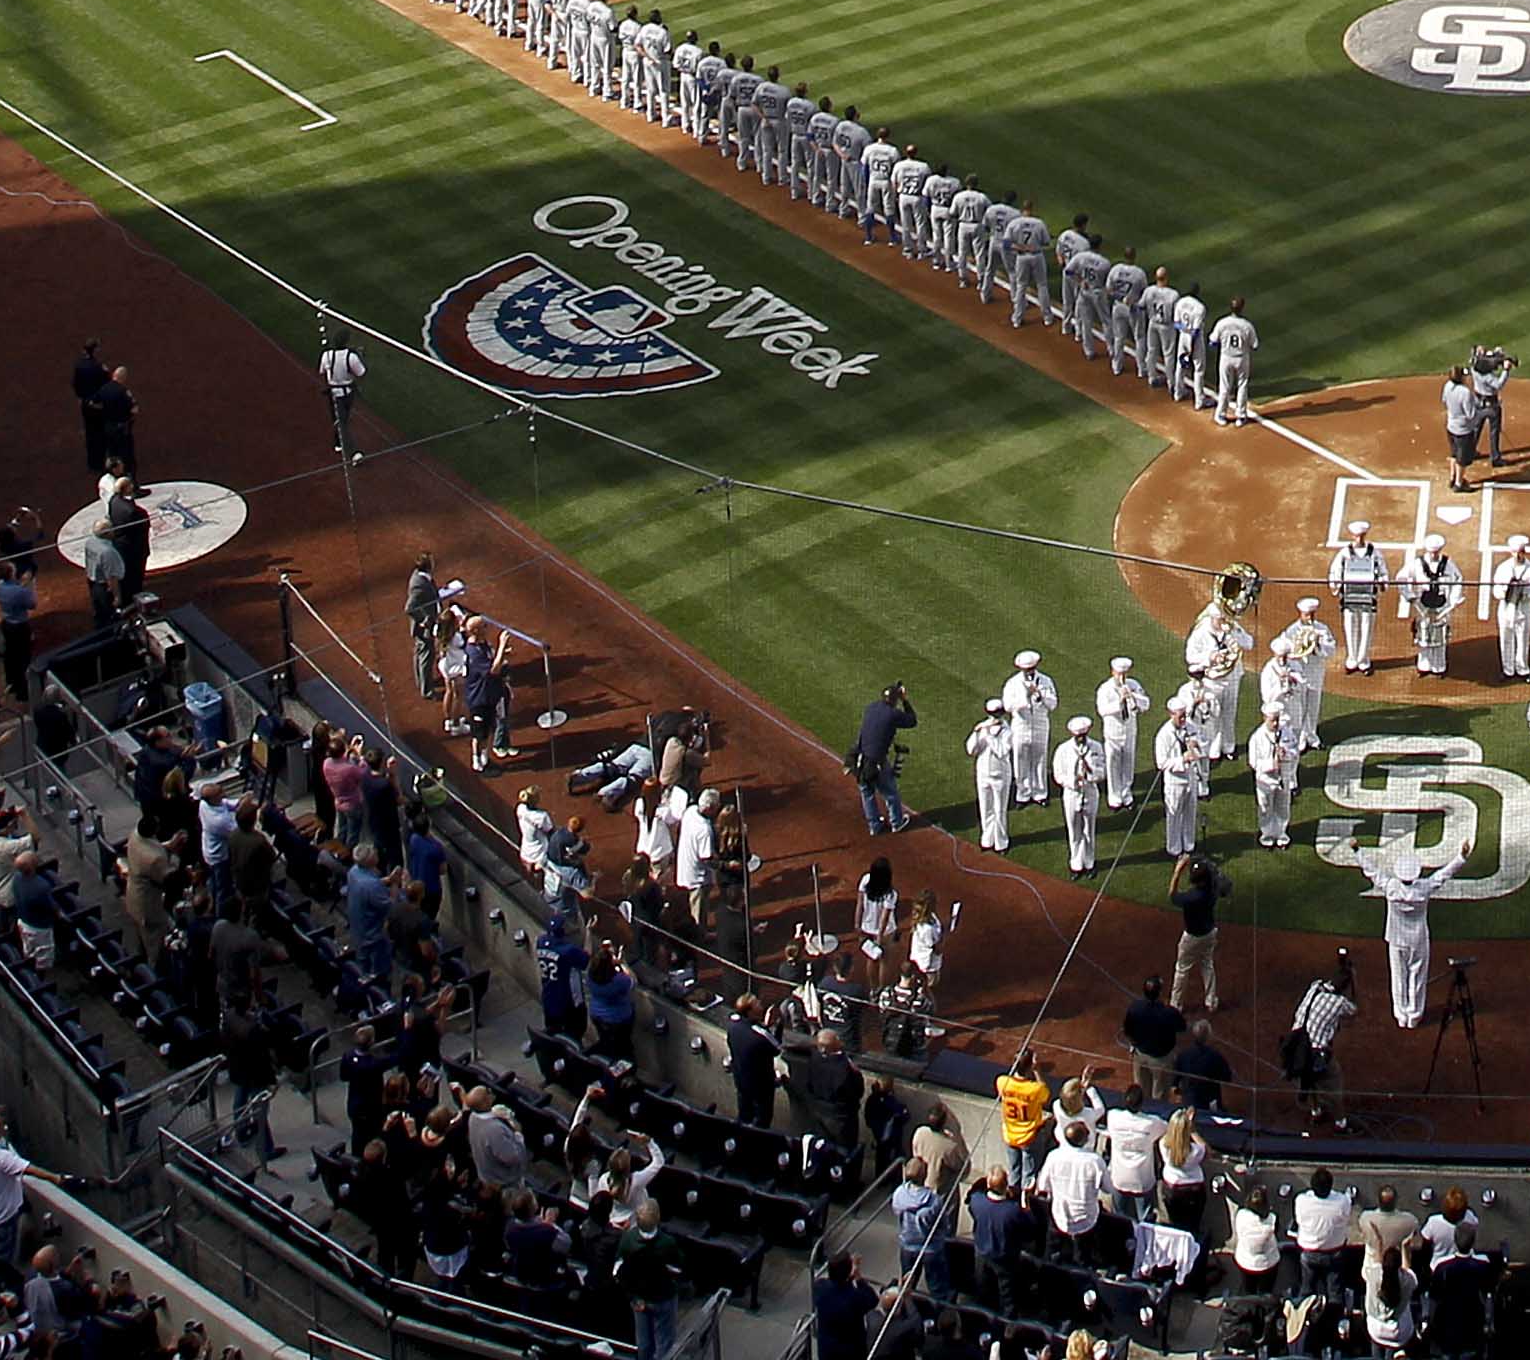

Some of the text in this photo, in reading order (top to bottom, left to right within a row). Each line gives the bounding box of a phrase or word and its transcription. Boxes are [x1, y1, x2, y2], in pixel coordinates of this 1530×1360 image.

[1023, 231, 1031, 244] 7
[533, 195, 879, 389] Opening Week
[1230, 334, 1239, 348] 8
[1006, 1101, 1028, 1121] 31
